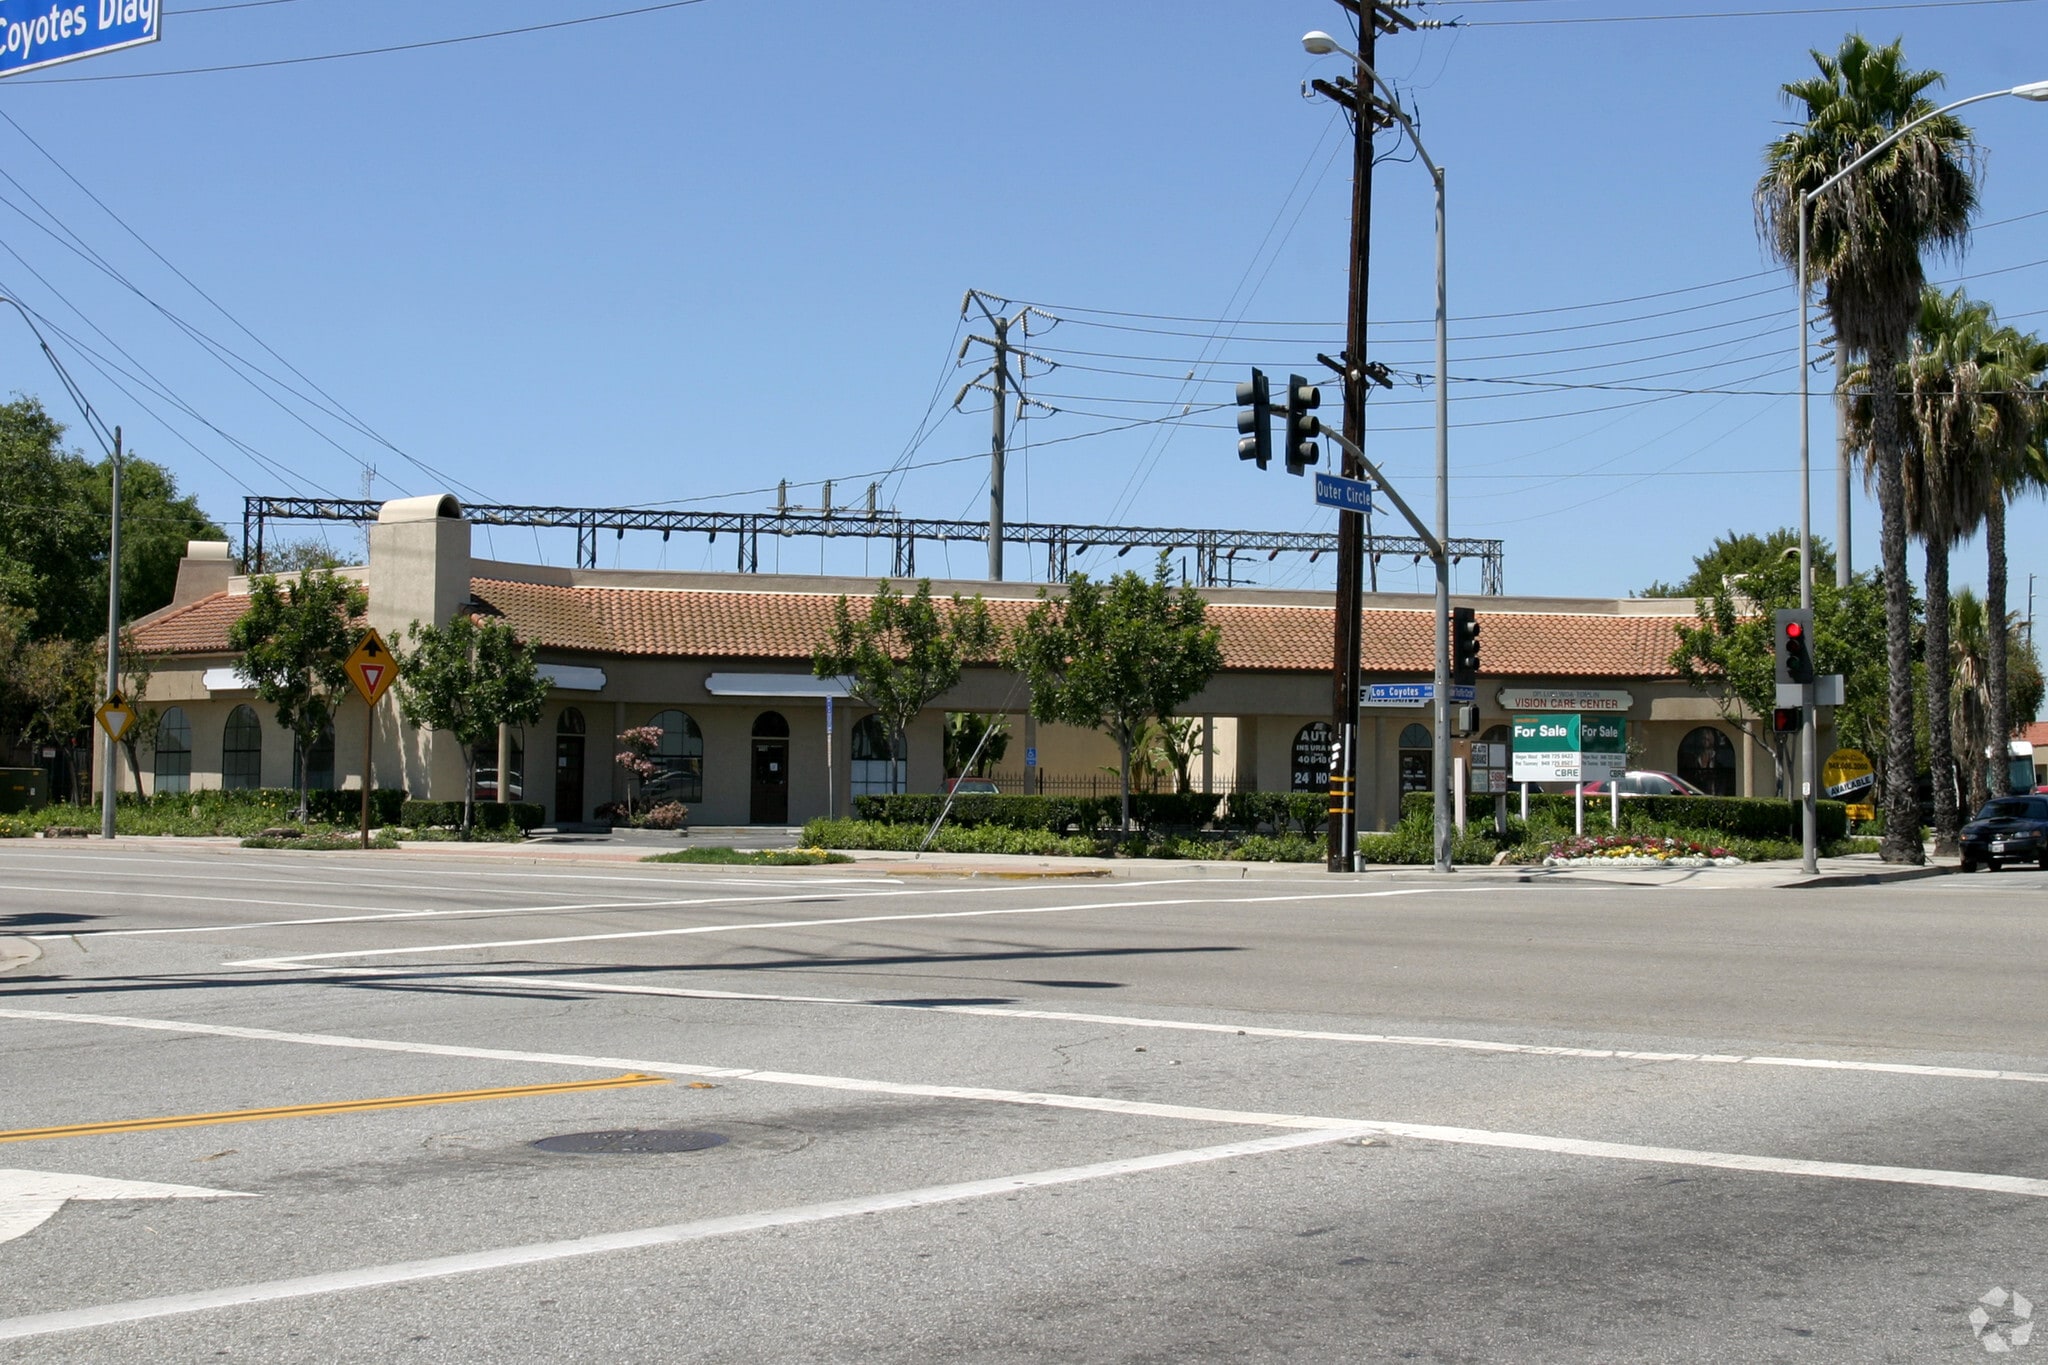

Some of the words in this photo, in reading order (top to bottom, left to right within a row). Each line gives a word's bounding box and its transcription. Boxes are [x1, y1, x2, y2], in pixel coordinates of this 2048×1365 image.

[1317, 480, 1342, 500] Outer
[1346, 486, 1371, 506] Circle
[1371, 687, 1385, 697] Los
[1389, 686, 1419, 699] Coyotes
[1515, 698, 1547, 708] VISION
[1550, 699, 1576, 709] CARE
[1580, 699, 1618, 709] CENTER
[1514, 725, 1536, 738] For
[1539, 724, 1567, 737] Sale
[1581, 724, 1597, 737] For
[1599, 725, 1618, 738] Sale
[1294, 772, 1309, 784] 24
[1554, 768, 1579, 777] CBRE
[1831, 775, 1871, 796] AVAILABLE
